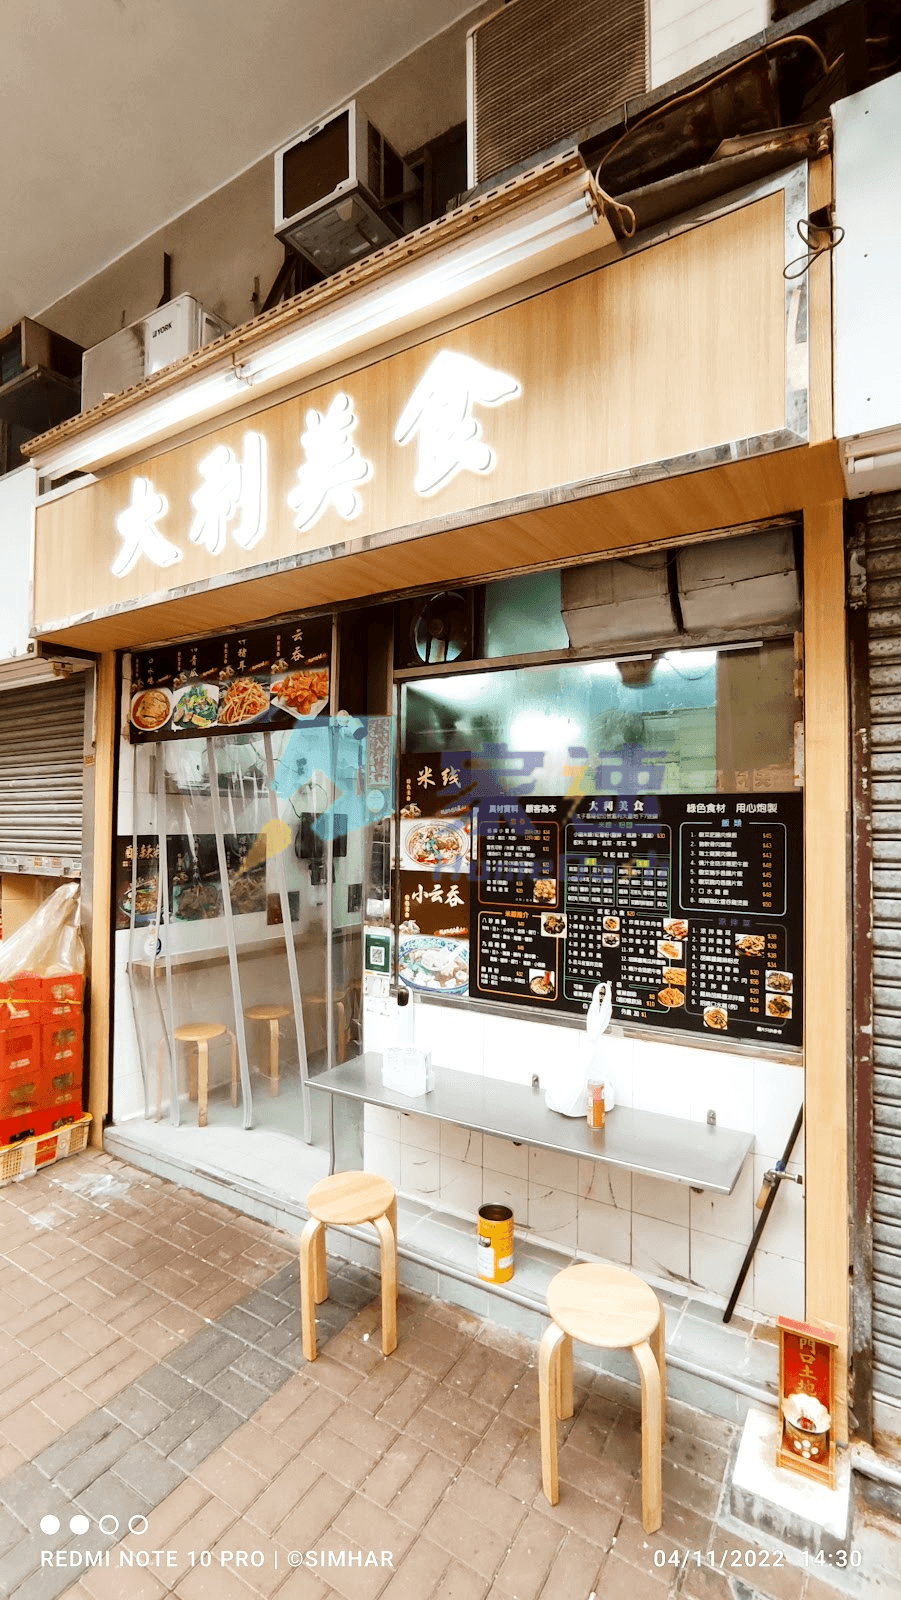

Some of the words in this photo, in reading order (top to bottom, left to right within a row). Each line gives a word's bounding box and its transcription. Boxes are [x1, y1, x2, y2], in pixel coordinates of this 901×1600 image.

[157, 321, 173, 336] YORK
[110, 349, 521, 577] 大利美食
[189, 648, 199, 678] 青瓜
[417, 765, 462, 790] 米线
[525, 804, 557, 814] 顧客為本
[589, 800, 644, 812] 大利美食
[686, 803, 726, 814] 綠色食材
[735, 803, 778, 814] 用心炮製
[411, 884, 465, 908] 小云吞
[795, 1336, 817, 1396] 門口土地
